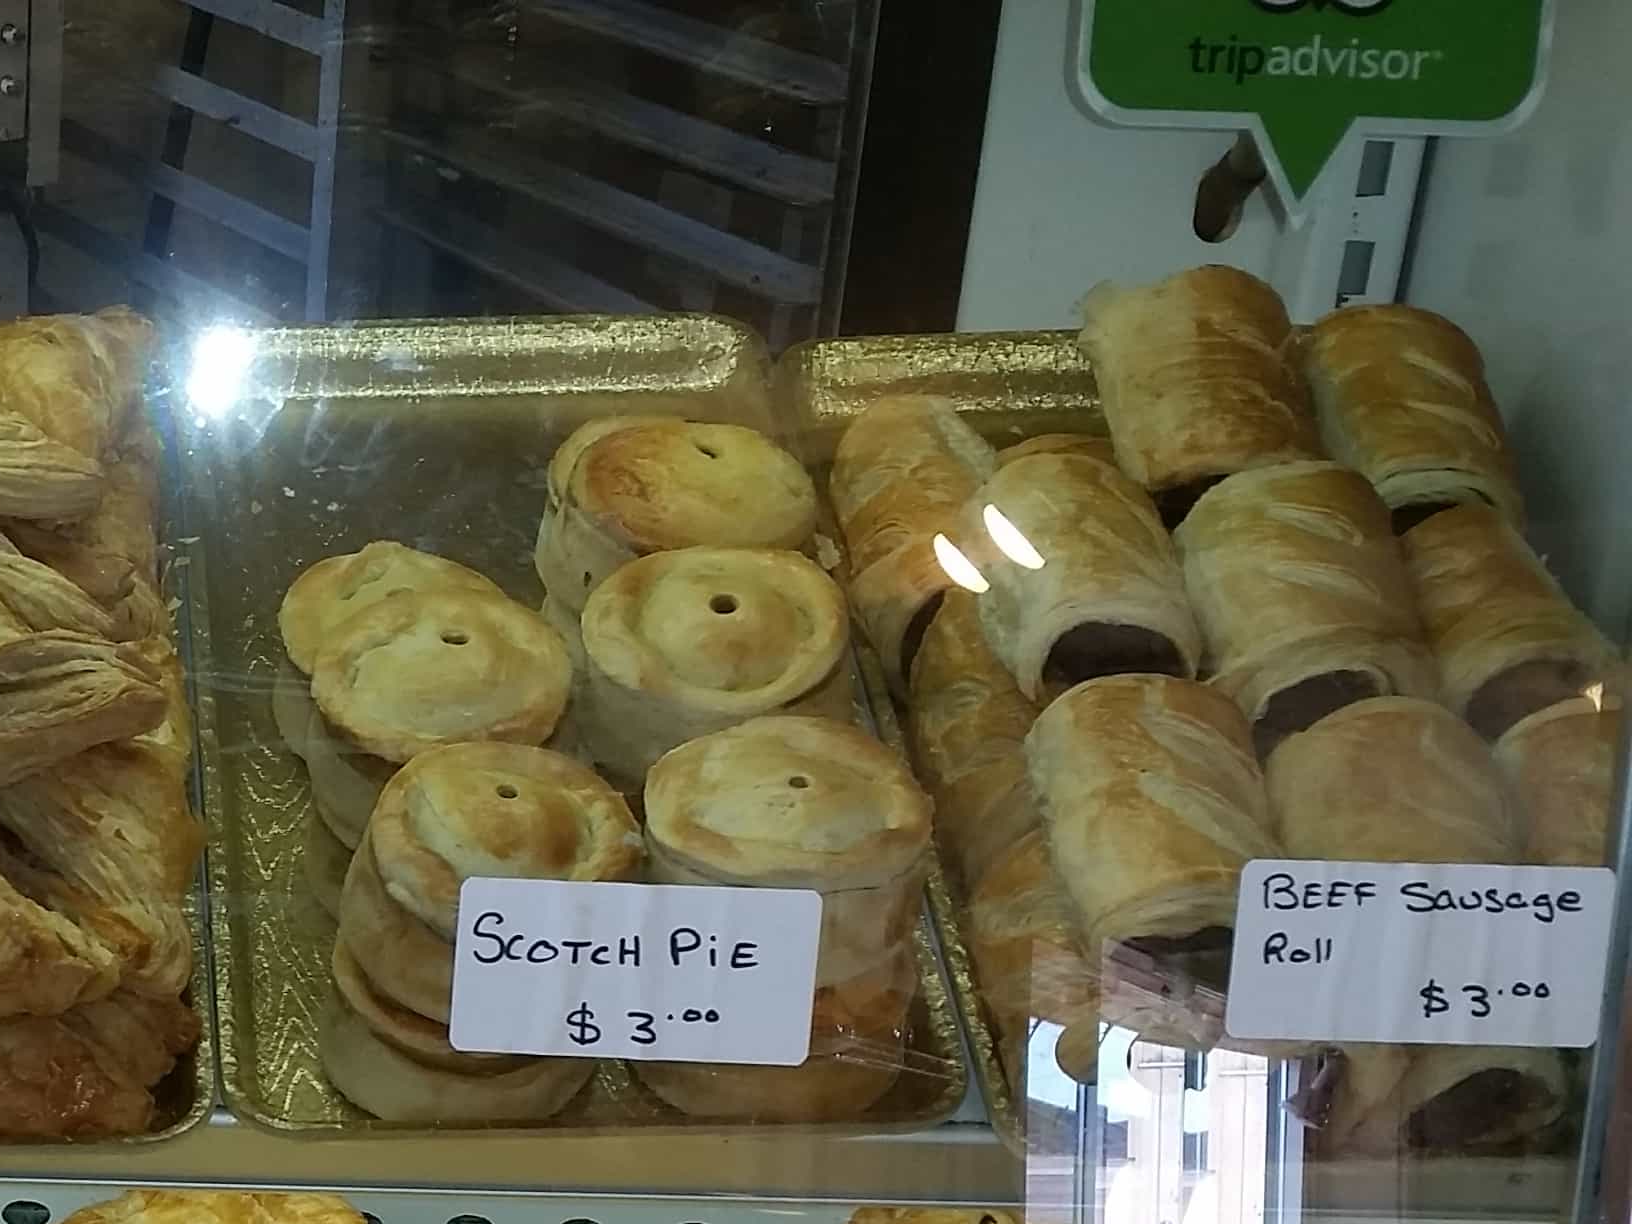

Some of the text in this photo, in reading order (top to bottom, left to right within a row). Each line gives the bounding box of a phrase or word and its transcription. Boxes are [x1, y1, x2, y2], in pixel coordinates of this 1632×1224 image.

[1189, 35, 1430, 85] tripadvisor
[1263, 874, 1583, 922] BEEF Sausage
[1263, 932, 1332, 964] Roll
